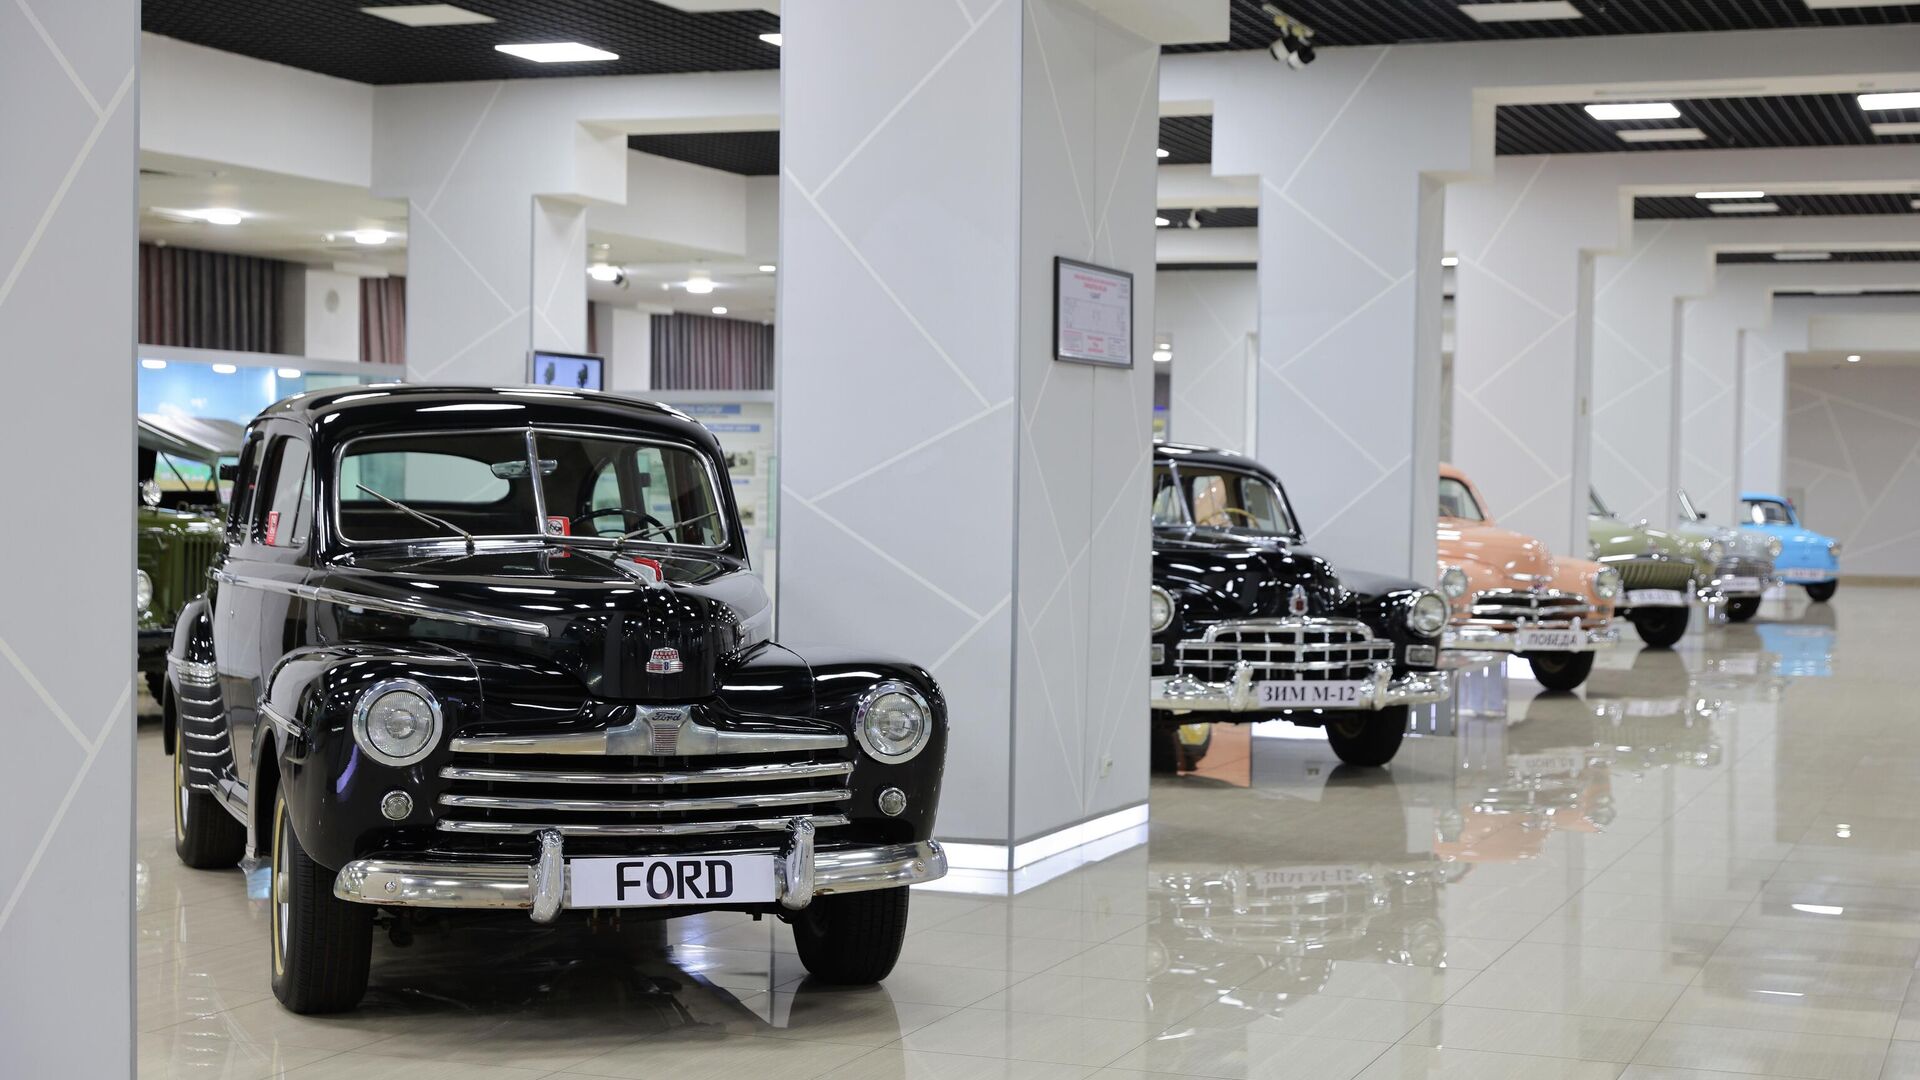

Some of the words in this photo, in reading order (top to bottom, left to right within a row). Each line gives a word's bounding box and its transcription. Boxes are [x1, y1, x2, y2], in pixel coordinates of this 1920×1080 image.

[1264, 686, 1306, 701] ЗИМ
[1312, 685, 1356, 701] М-12
[652, 711, 682, 721] Ford
[616, 859, 734, 901] FORD
